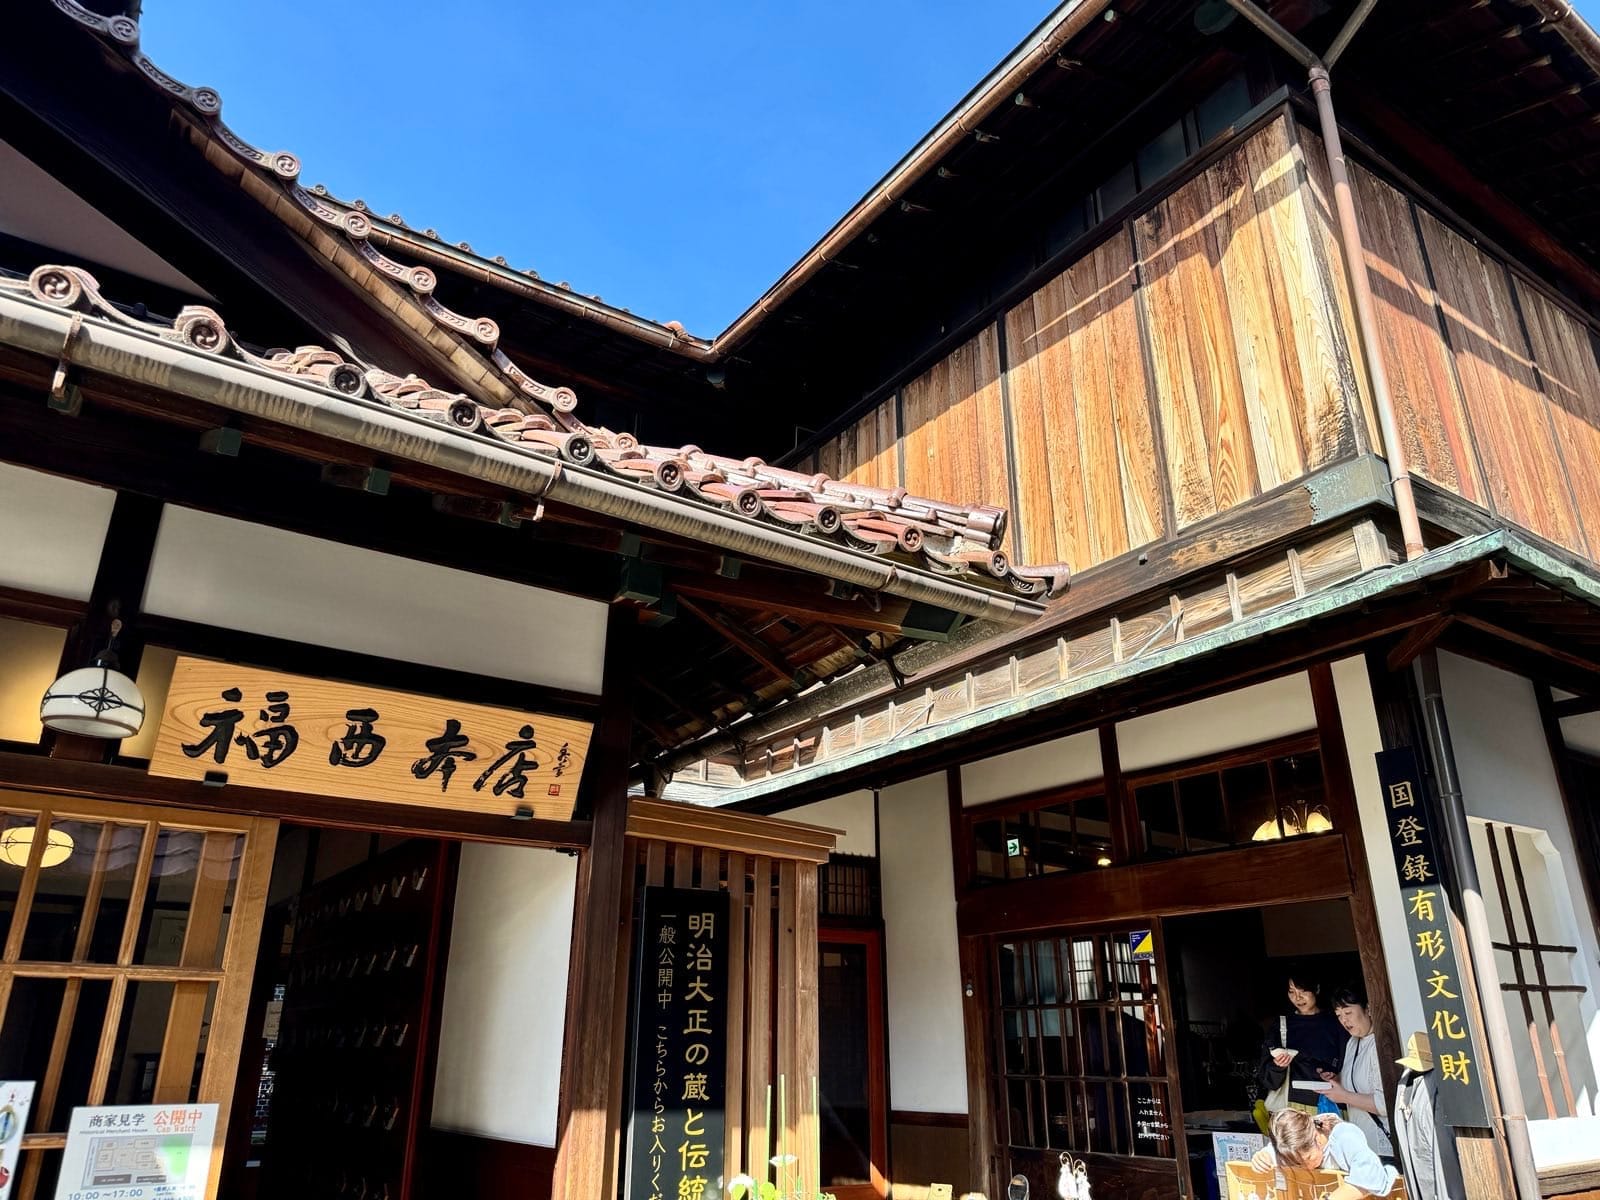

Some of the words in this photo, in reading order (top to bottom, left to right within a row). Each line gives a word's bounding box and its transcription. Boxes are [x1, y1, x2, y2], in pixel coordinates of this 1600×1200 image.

[181, 687, 539, 799] 福西本店
[656, 913, 677, 1010] 一般公開中
[1388, 780, 1472, 1086] 国登録有形文化財
[678, 912, 715, 1200] 明治大正の蔵と伝統
[89, 1113, 146, 1128] 商家見学
[153, 1109, 203, 1126] 公開中
